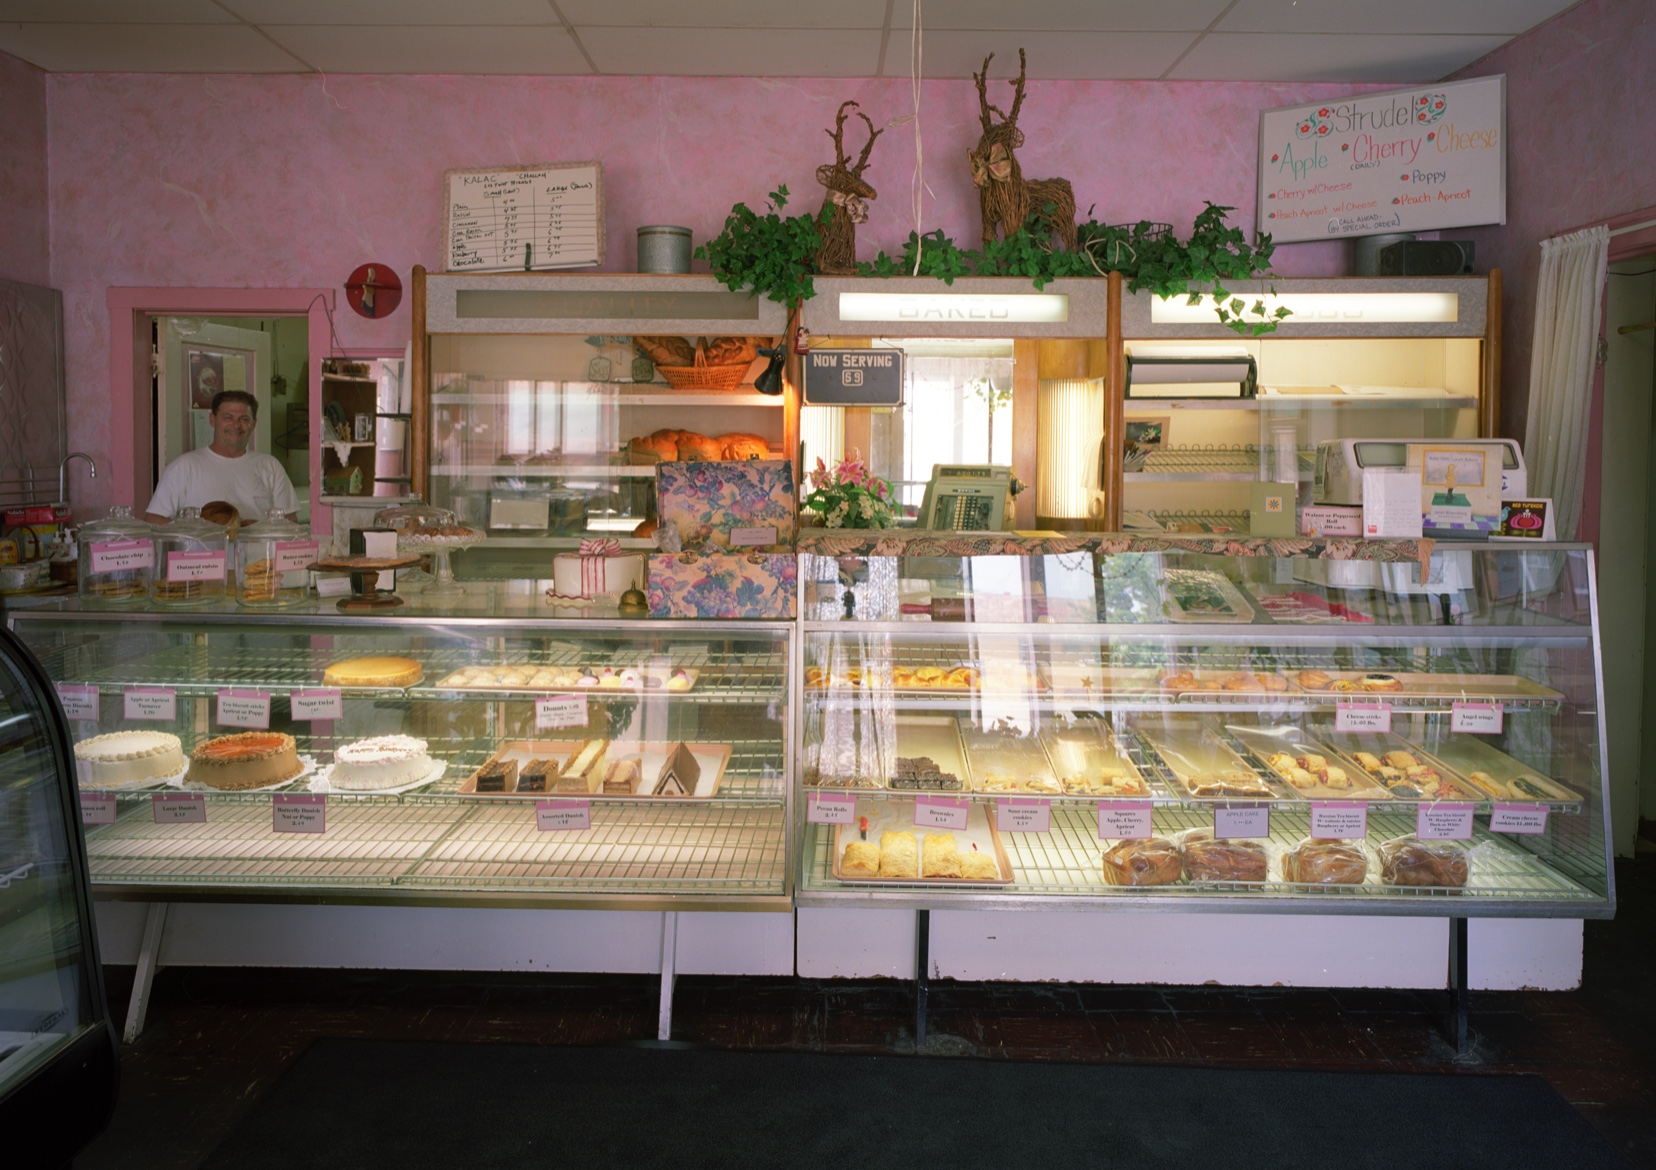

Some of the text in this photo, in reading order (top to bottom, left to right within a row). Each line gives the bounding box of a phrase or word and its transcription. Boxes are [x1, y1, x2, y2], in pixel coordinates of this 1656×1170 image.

[1336, 95, 1415, 134] Strudel
[1436, 123, 1497, 153] Cheese
[1353, 134, 1422, 165] Cherry
[1279, 141, 1328, 181] Apple
[1412, 169, 1446, 184] Poppy
[1277, 188, 1306, 200] Cherry
[1401, 192, 1431, 205] Peach
[1437, 188, 1471, 203] Apricot
[1346, 201, 1377, 211] Cheese
[1342, 223, 1371, 232] SPECIAL
